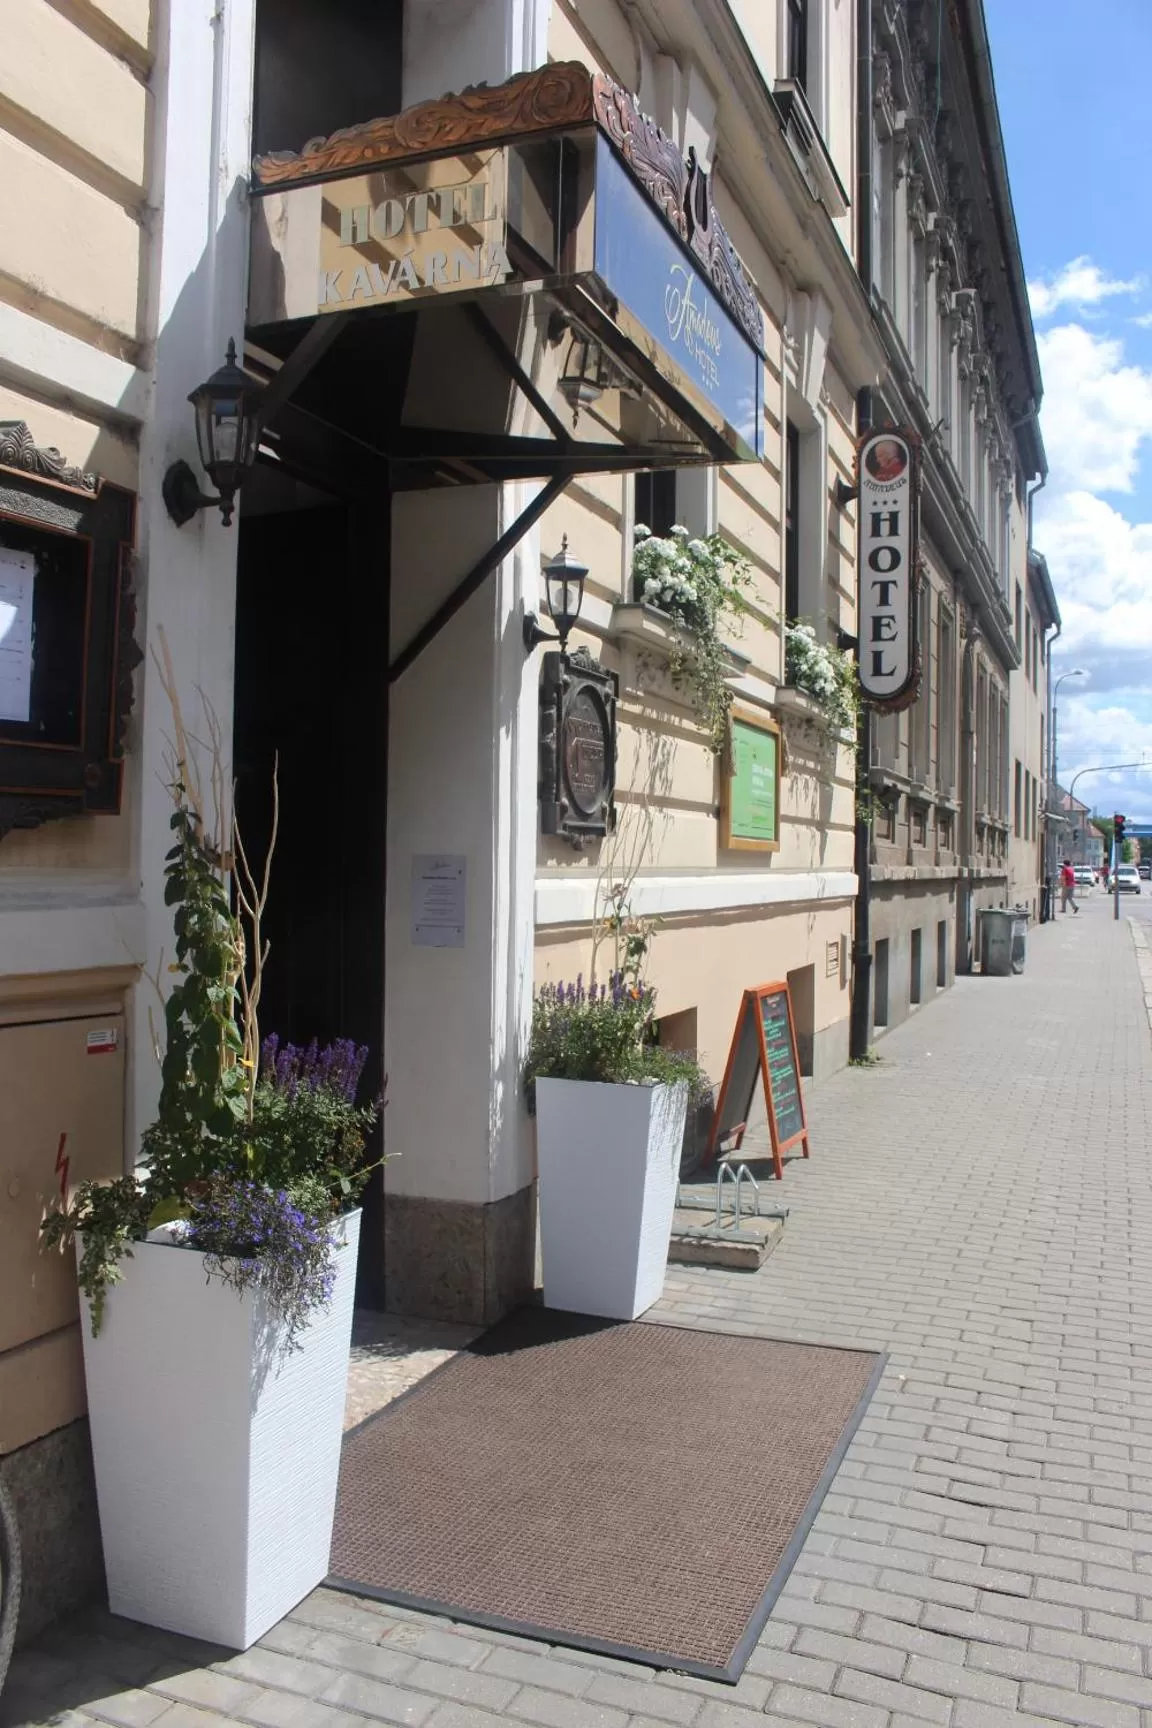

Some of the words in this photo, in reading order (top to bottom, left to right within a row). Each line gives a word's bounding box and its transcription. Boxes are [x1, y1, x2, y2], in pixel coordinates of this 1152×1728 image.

[338, 182, 498, 247] HOTEL
[317, 241, 514, 305] KAVÁRNA
[694, 343, 720, 387] HOTEL
[868, 511, 902, 677] HOTEL
